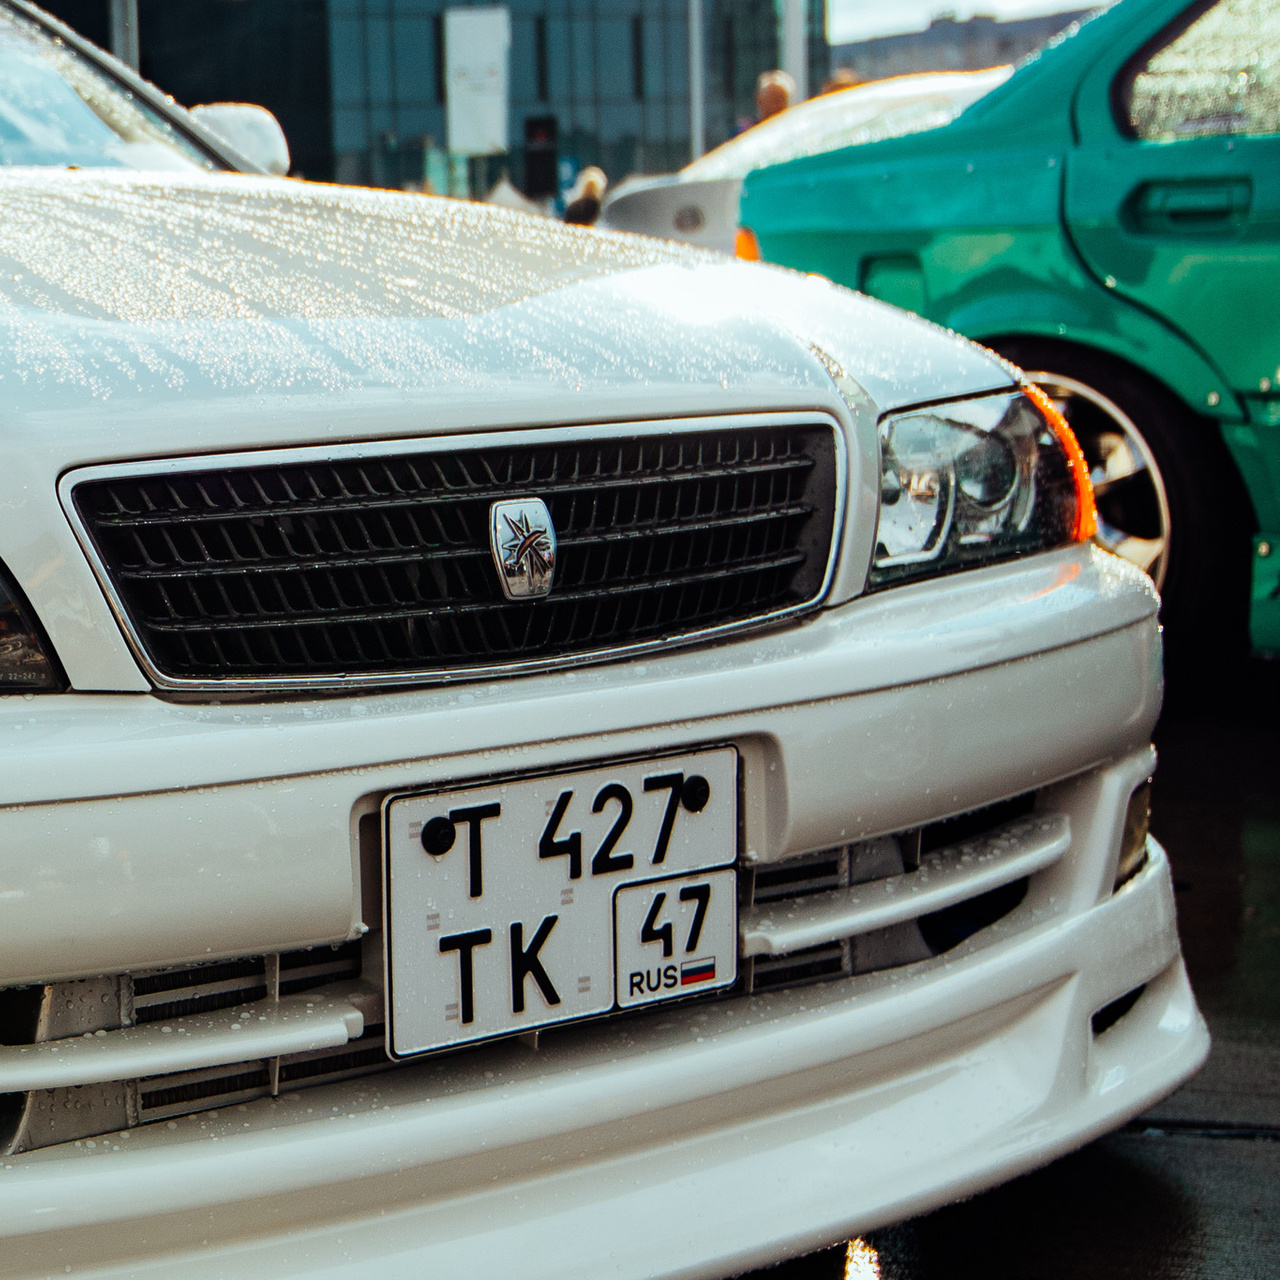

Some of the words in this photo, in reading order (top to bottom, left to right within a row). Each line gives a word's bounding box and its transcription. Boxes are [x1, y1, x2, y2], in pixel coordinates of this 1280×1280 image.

[448, 802, 501, 898] T
[538, 772, 685, 880] 427
[641, 883, 711, 958] 47
[439, 915, 561, 1025] TK
[629, 965, 679, 997] RUS
